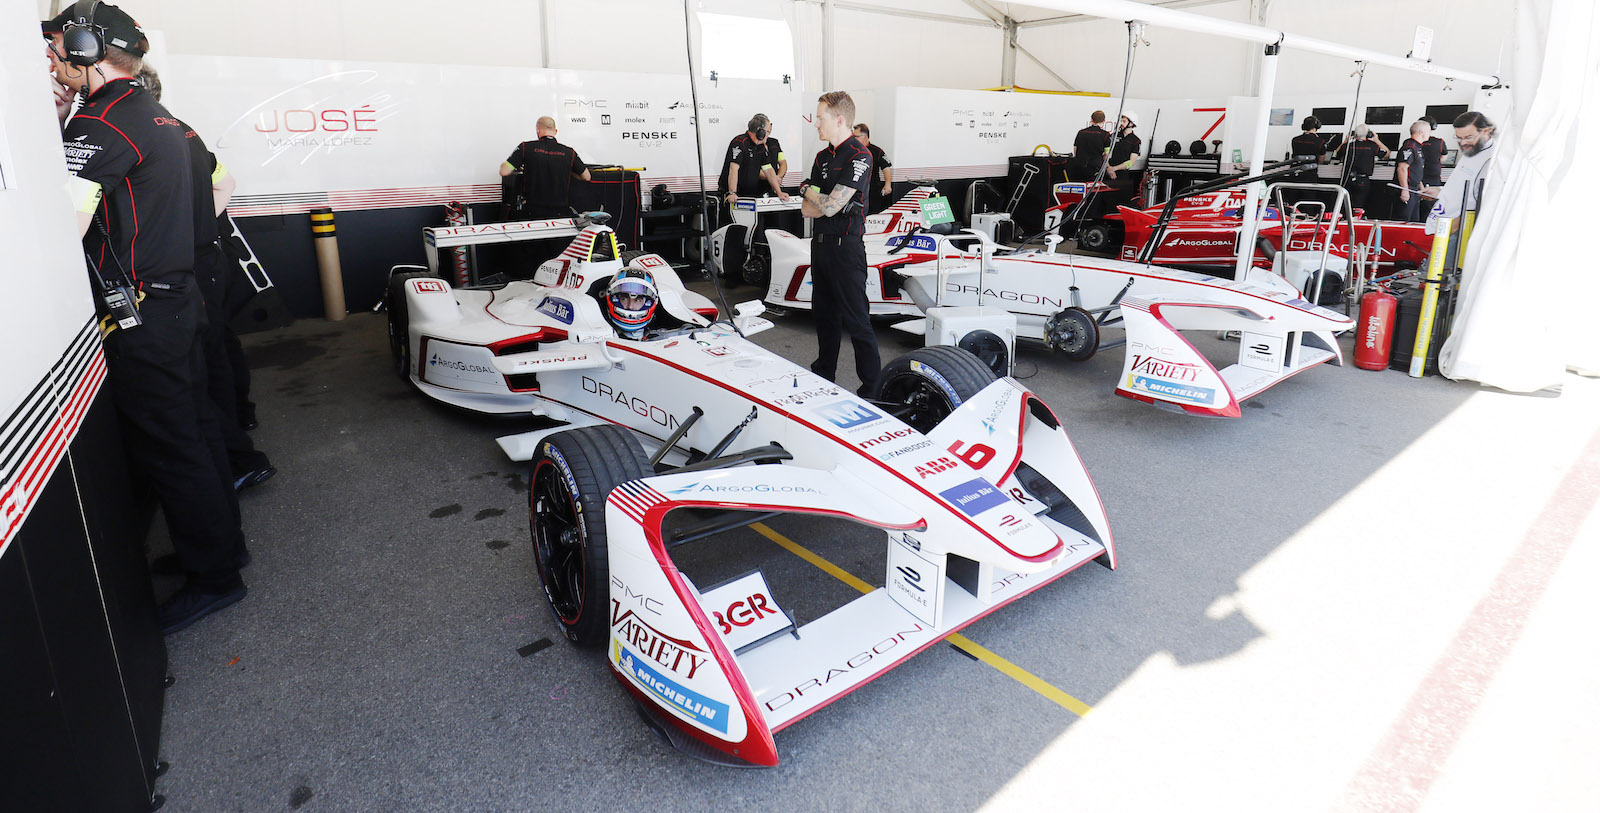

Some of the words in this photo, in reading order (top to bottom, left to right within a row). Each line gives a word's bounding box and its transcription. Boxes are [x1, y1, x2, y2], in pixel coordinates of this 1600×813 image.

[564, 99, 608, 109] PMC
[254, 104, 379, 133] JOSÉ
[621, 131, 678, 140] PENSKE
[923, 203, 945, 212] GREEN
[929, 211, 948, 220] LIGHT
[1048, 215, 1056, 229] 7
[945, 282, 1062, 308] DRAGON
[556, 303, 570, 319] Bär
[1365, 315, 1381, 349] lifeline
[1131, 341, 1175, 356] PMC
[1130, 354, 1203, 382] VARIETY
[1149, 383, 1208, 399] MICHELIN
[581, 375, 688, 438] DRAGON
[858, 427, 917, 450] molex
[887, 438, 935, 460] FANBOOST
[947, 439, 998, 471] 6
[551, 448, 577, 497] MICHELIN
[912, 456, 958, 480] ABB
[955, 491, 981, 507] Julius
[979, 486, 995, 501] Bär
[611, 574, 664, 616] PMC
[610, 597, 711, 680] VARIETY
[765, 623, 923, 712] DRAGON
[636, 667, 717, 721] MICHELIN
